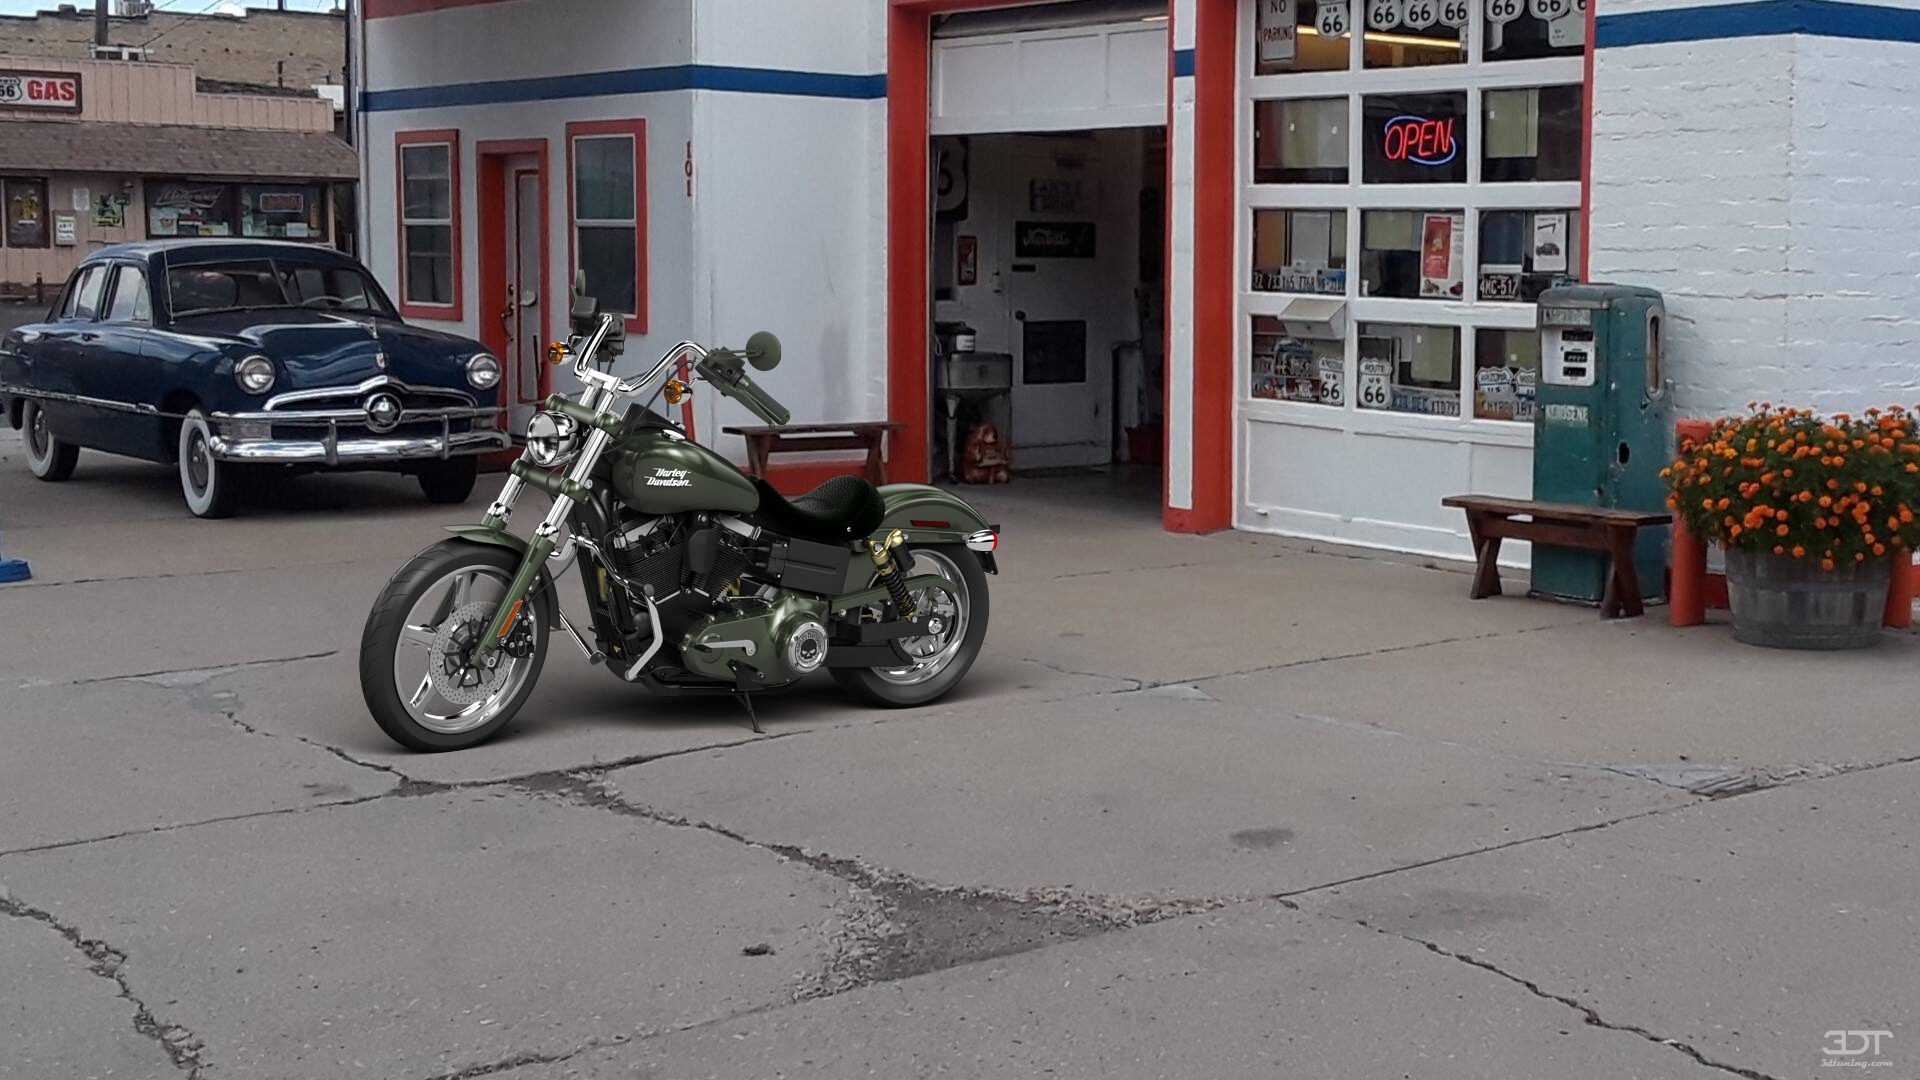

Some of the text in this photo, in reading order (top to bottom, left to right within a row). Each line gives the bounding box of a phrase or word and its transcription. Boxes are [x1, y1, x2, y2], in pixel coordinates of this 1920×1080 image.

[1270, 0, 1287, 14] NO
[1373, 6, 1395, 24] 66
[1409, 3, 1431, 22] 66
[1445, 2, 1467, 21] 66
[1492, 0, 1515, 16] 66
[1537, 0, 1561, 13] 66
[1263, 25, 1293, 42] PARKING
[1322, 15, 1343, 34] 66
[27, 80, 75, 101] GAS
[1385, 118, 1455, 160] OPEN
[1321, 381, 1340, 400] 66
[1364, 386, 1385, 404] 66
[644, 475, 692, 487] Davidson
